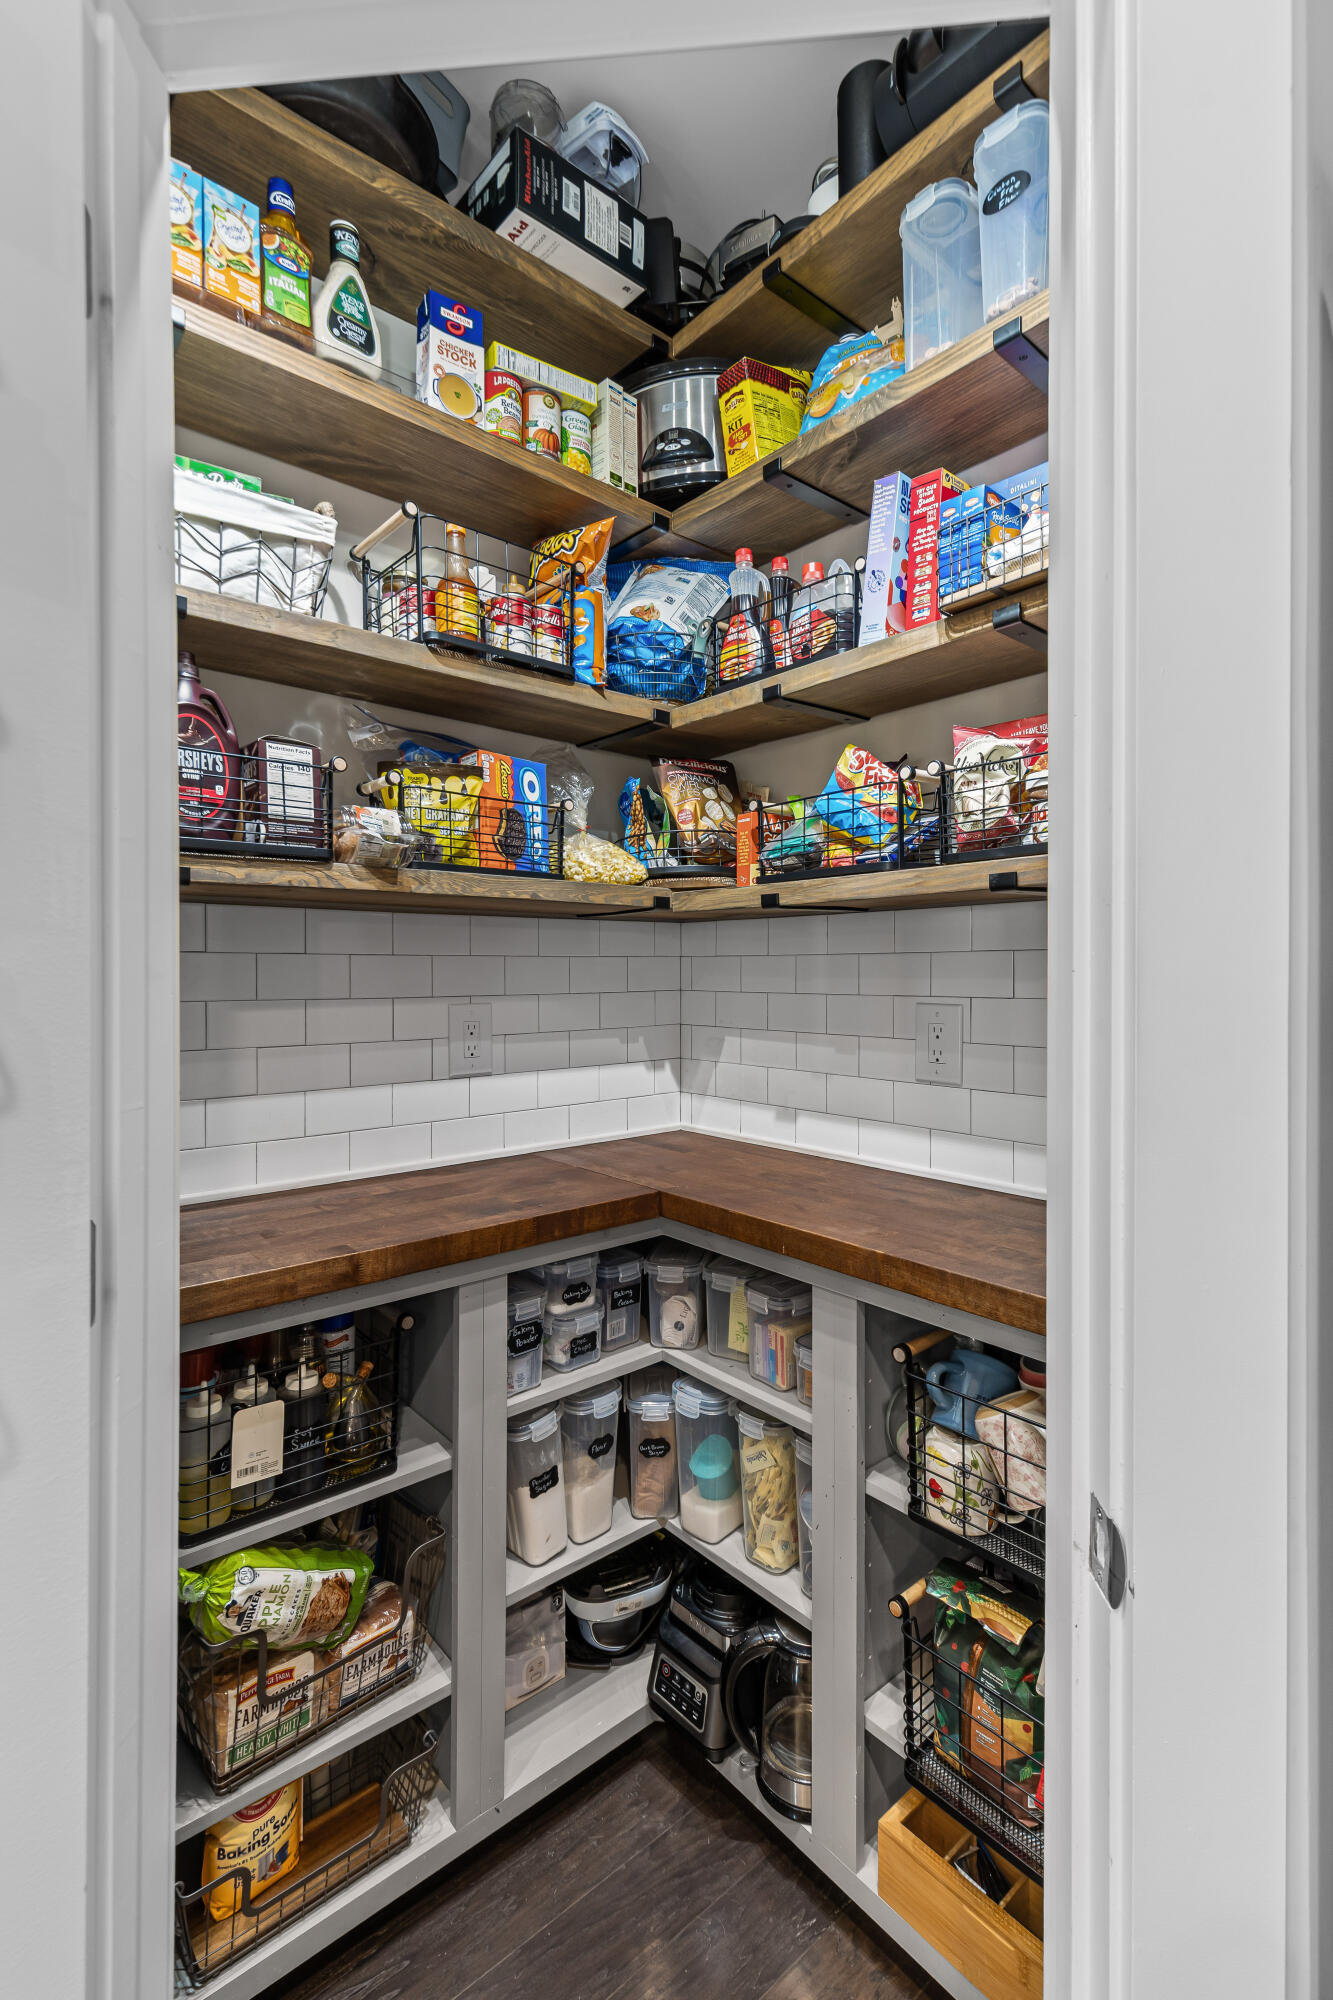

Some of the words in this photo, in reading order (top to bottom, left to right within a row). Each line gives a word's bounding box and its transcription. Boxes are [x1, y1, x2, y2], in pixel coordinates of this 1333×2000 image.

[442, 309, 472, 327] SWANSON
[437, 345, 477, 369] STOCK
[439, 339, 475, 359] CHICKEN
[564, 413, 588, 428] Green
[568, 422, 588, 434] Giant
[728, 416, 743, 433] KIT
[1011, 477, 1037, 494] DITALINI
[268, 744, 295, 754] Nutrition
[295, 748, 311, 756] Facts
[297, 765, 311, 773] 140
[659, 757, 729, 774] Drizzilicious
[500, 759, 511, 799] Reese's
[667, 774, 720, 786] CINNAMON
[522, 770, 542, 860] OREO
[591, 1441, 607, 1455] Flour
[290, 1588, 302, 1616] CAKES
[240, 1590, 263, 1633] QUAKER
[236, 1731, 273, 1759] HEARTY
[252, 1815, 276, 1840] pure
[217, 1831, 270, 1861] Baking
